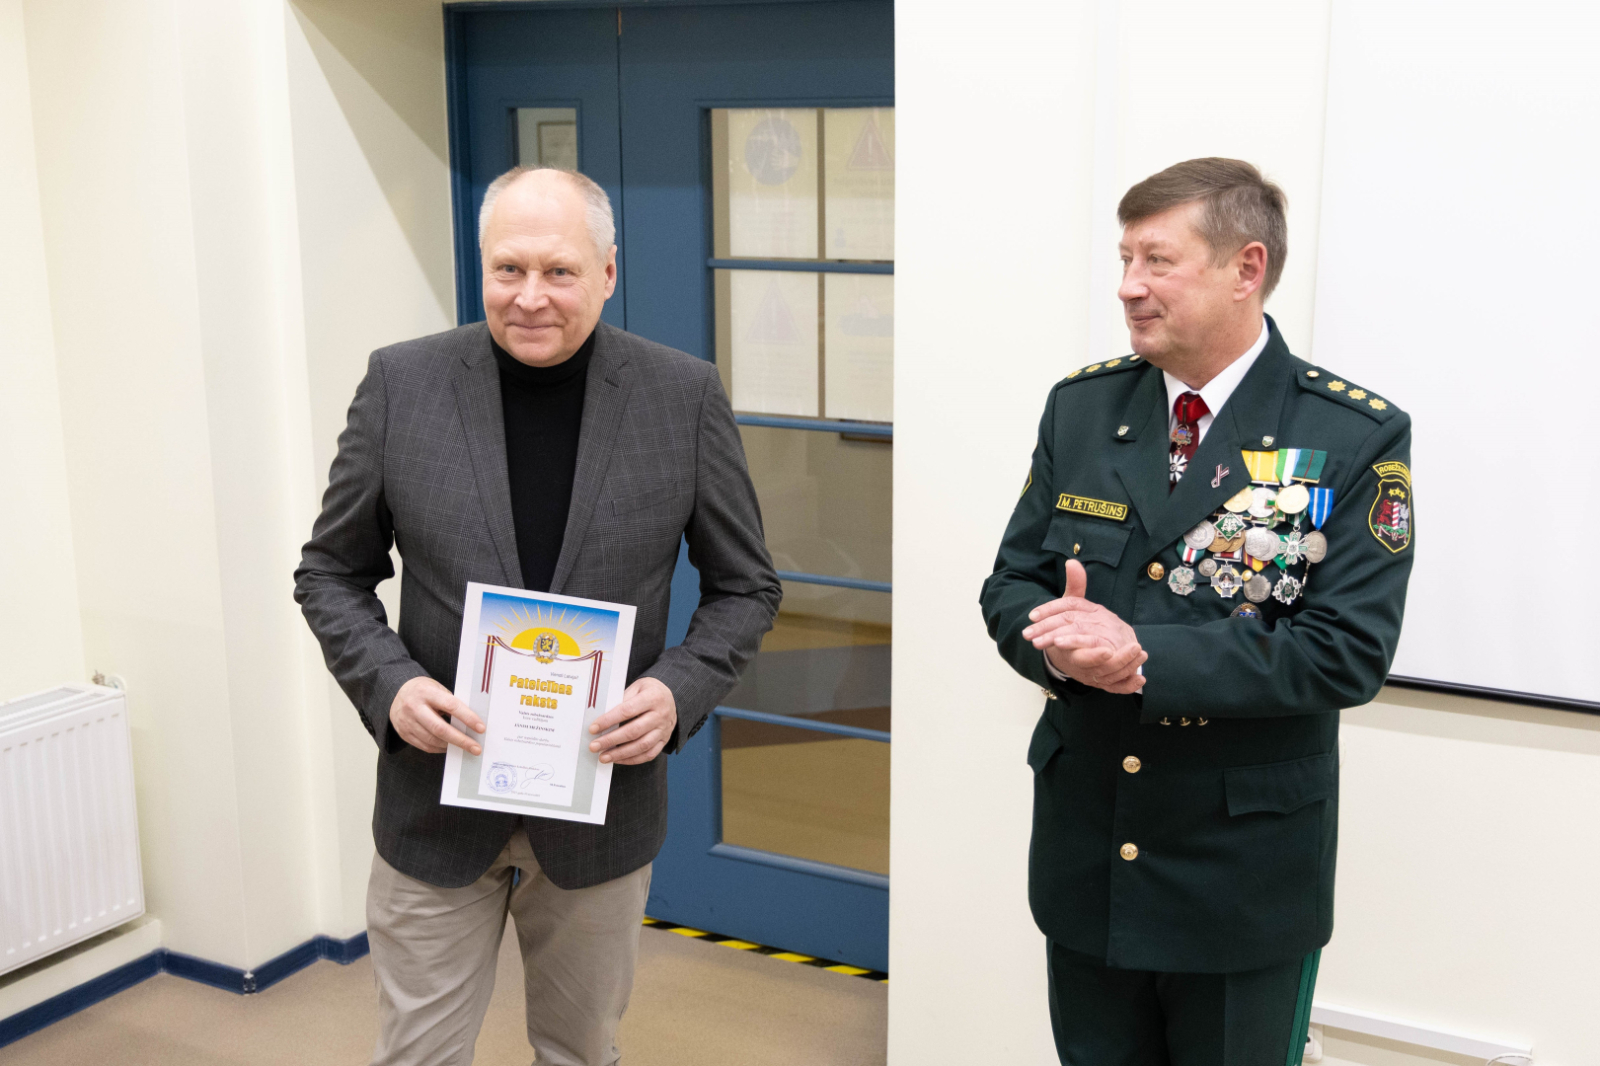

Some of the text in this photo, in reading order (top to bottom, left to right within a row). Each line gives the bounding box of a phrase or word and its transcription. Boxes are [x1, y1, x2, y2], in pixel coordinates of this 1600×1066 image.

[1061, 497, 1123, 517] M. PETRUŠINS
[509, 675, 573, 695] Pateicības
[520, 694, 558, 710] raksts
